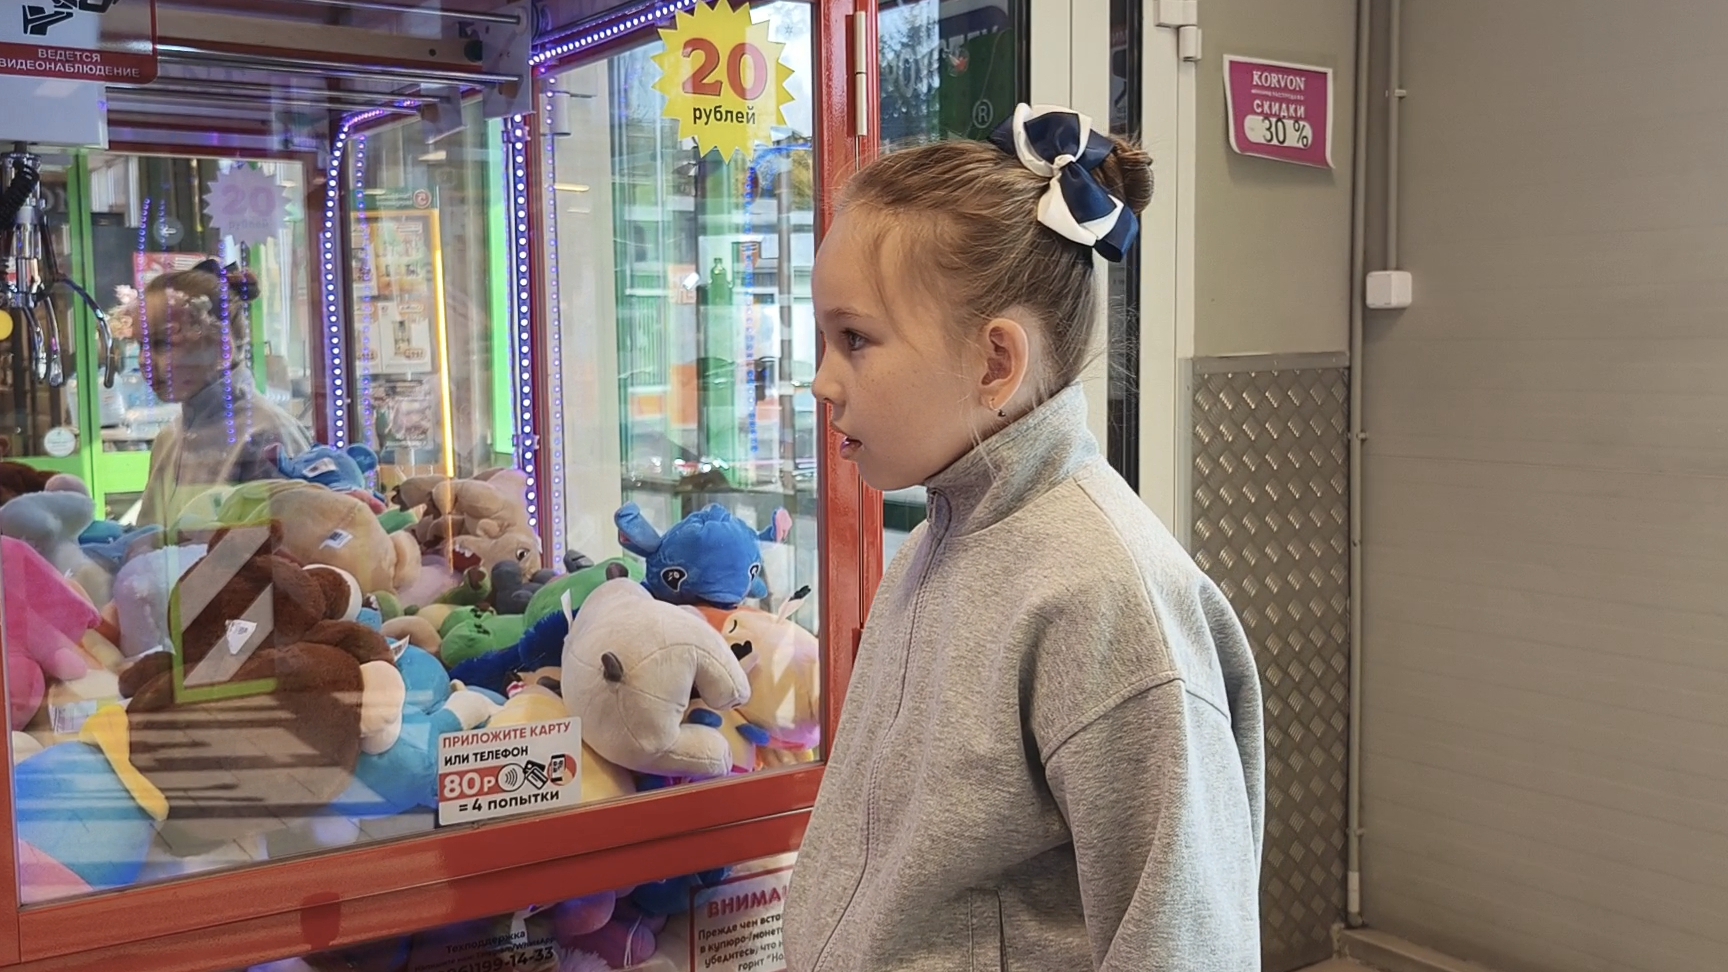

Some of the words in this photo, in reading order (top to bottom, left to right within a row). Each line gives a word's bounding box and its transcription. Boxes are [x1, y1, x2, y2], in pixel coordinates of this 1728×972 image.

[38, 48, 101, 62] ВЕДЕТСЯ
[0, 57, 140, 78] ВИДЕОНАБЛЮДЕНИЕ
[682, 37, 768, 101] 20
[1252, 70, 1306, 91] KORVON
[693, 105, 756, 125] рублей
[1253, 99, 1305, 118] СКИДКИ
[443, 727, 527, 748] ПРИЛОЖИТЕ
[530, 721, 571, 737] КАРТУ
[444, 753, 470, 766] ИЛИ
[472, 745, 528, 762] ТЕЛЕФОН
[472, 798, 482, 812] 4
[488, 790, 560, 811] ПОПЫТКИ
[446, 930, 526, 954] Техподдержка
[698, 924, 738, 940] Прежде
[760, 941, 777, 952] что
